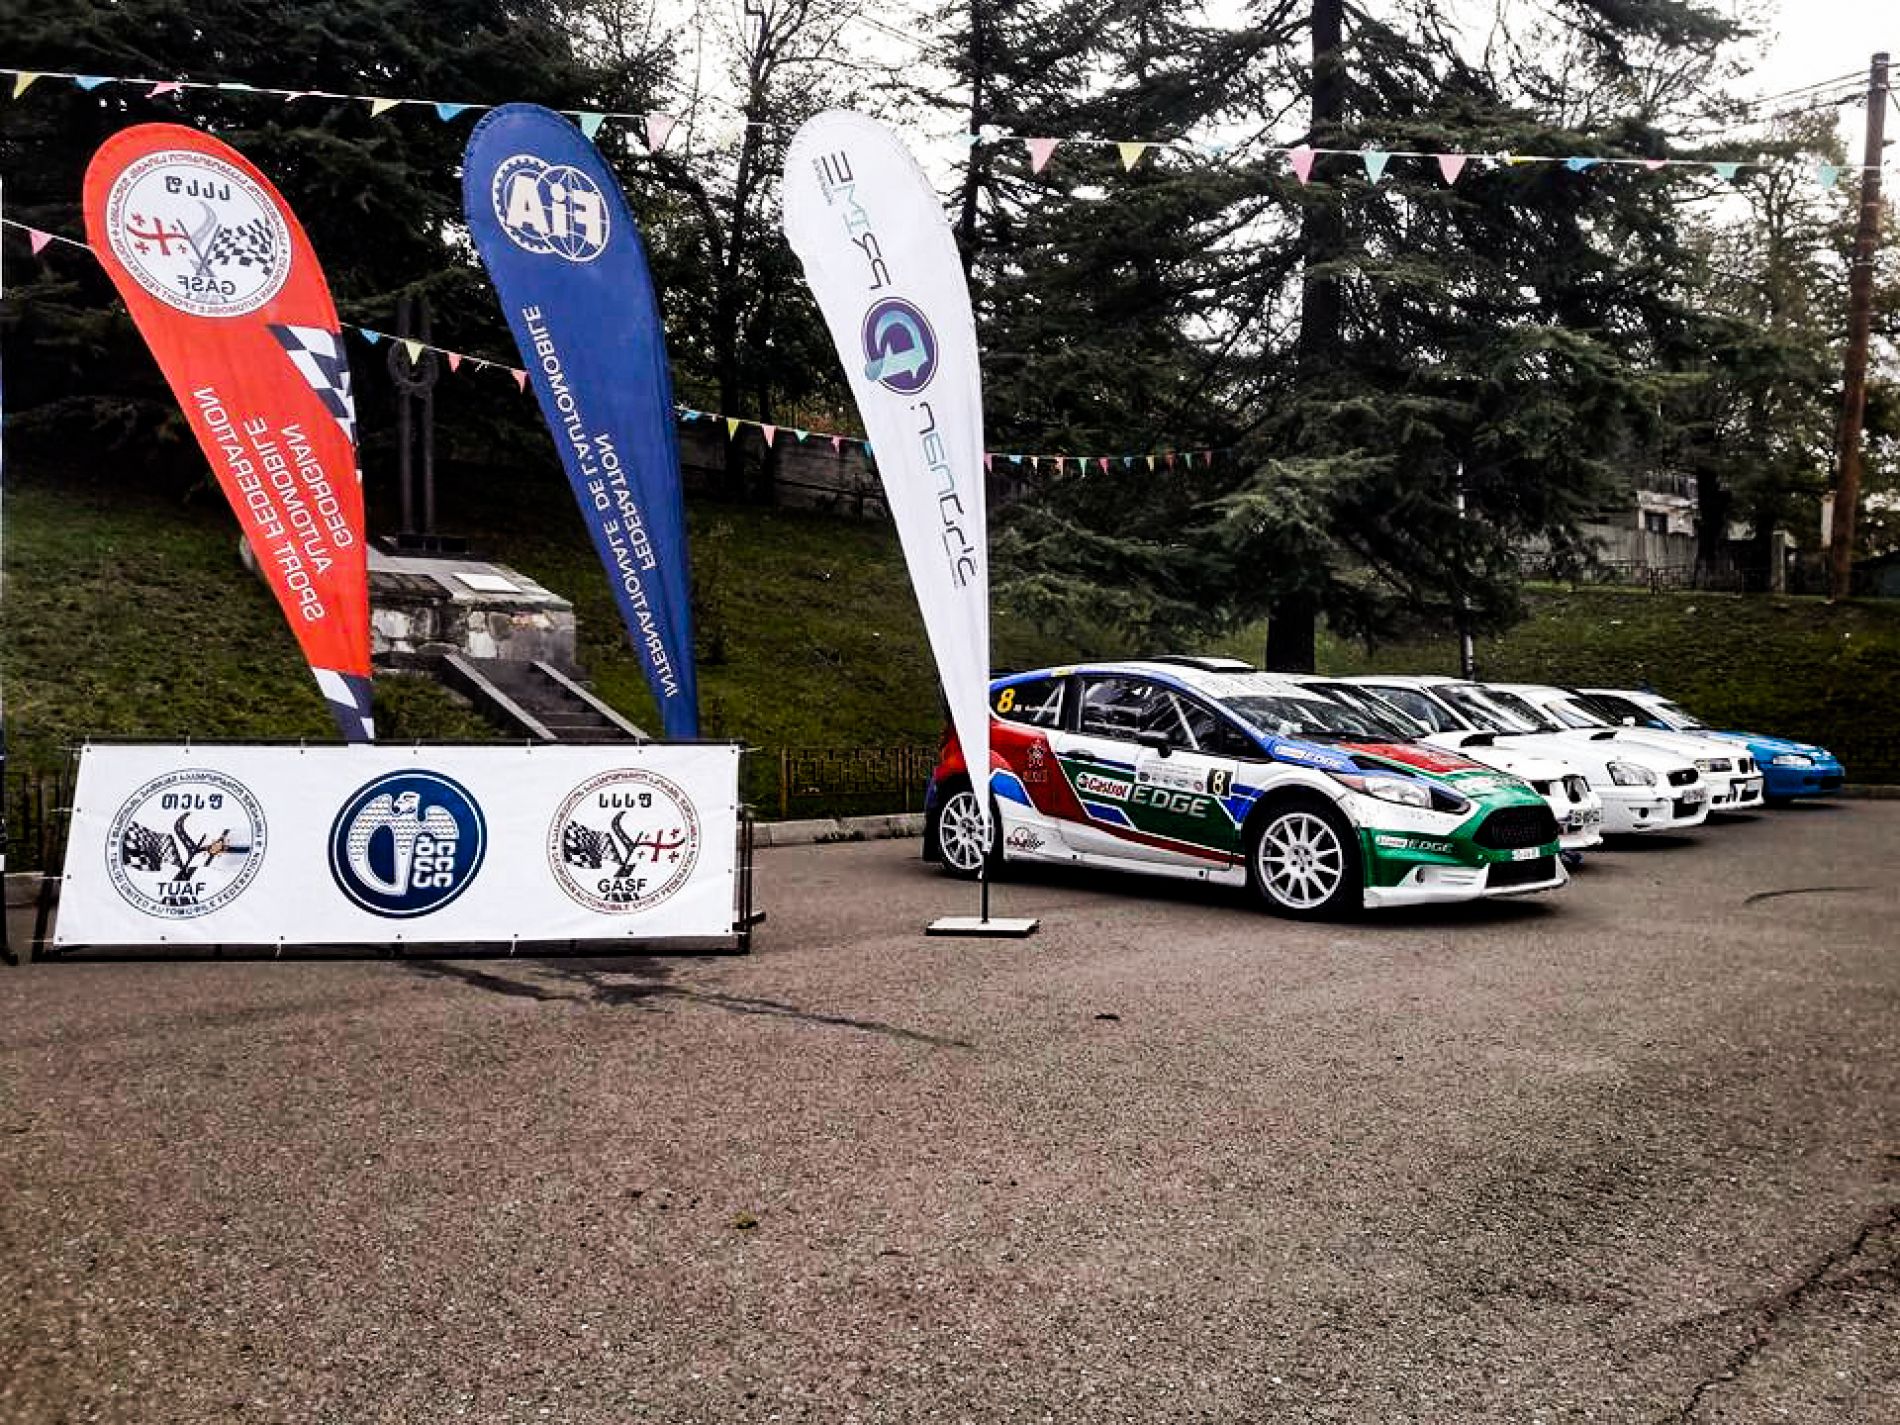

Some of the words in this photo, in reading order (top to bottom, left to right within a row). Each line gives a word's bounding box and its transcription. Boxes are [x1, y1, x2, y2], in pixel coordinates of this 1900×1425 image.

[997, 688, 1016, 713] 8
[1212, 771, 1226, 795] 8
[1088, 776, 1129, 798] Castrol
[1132, 784, 1211, 818] EDGE
[156, 881, 207, 896] TUAF
[597, 878, 648, 893] GASF
